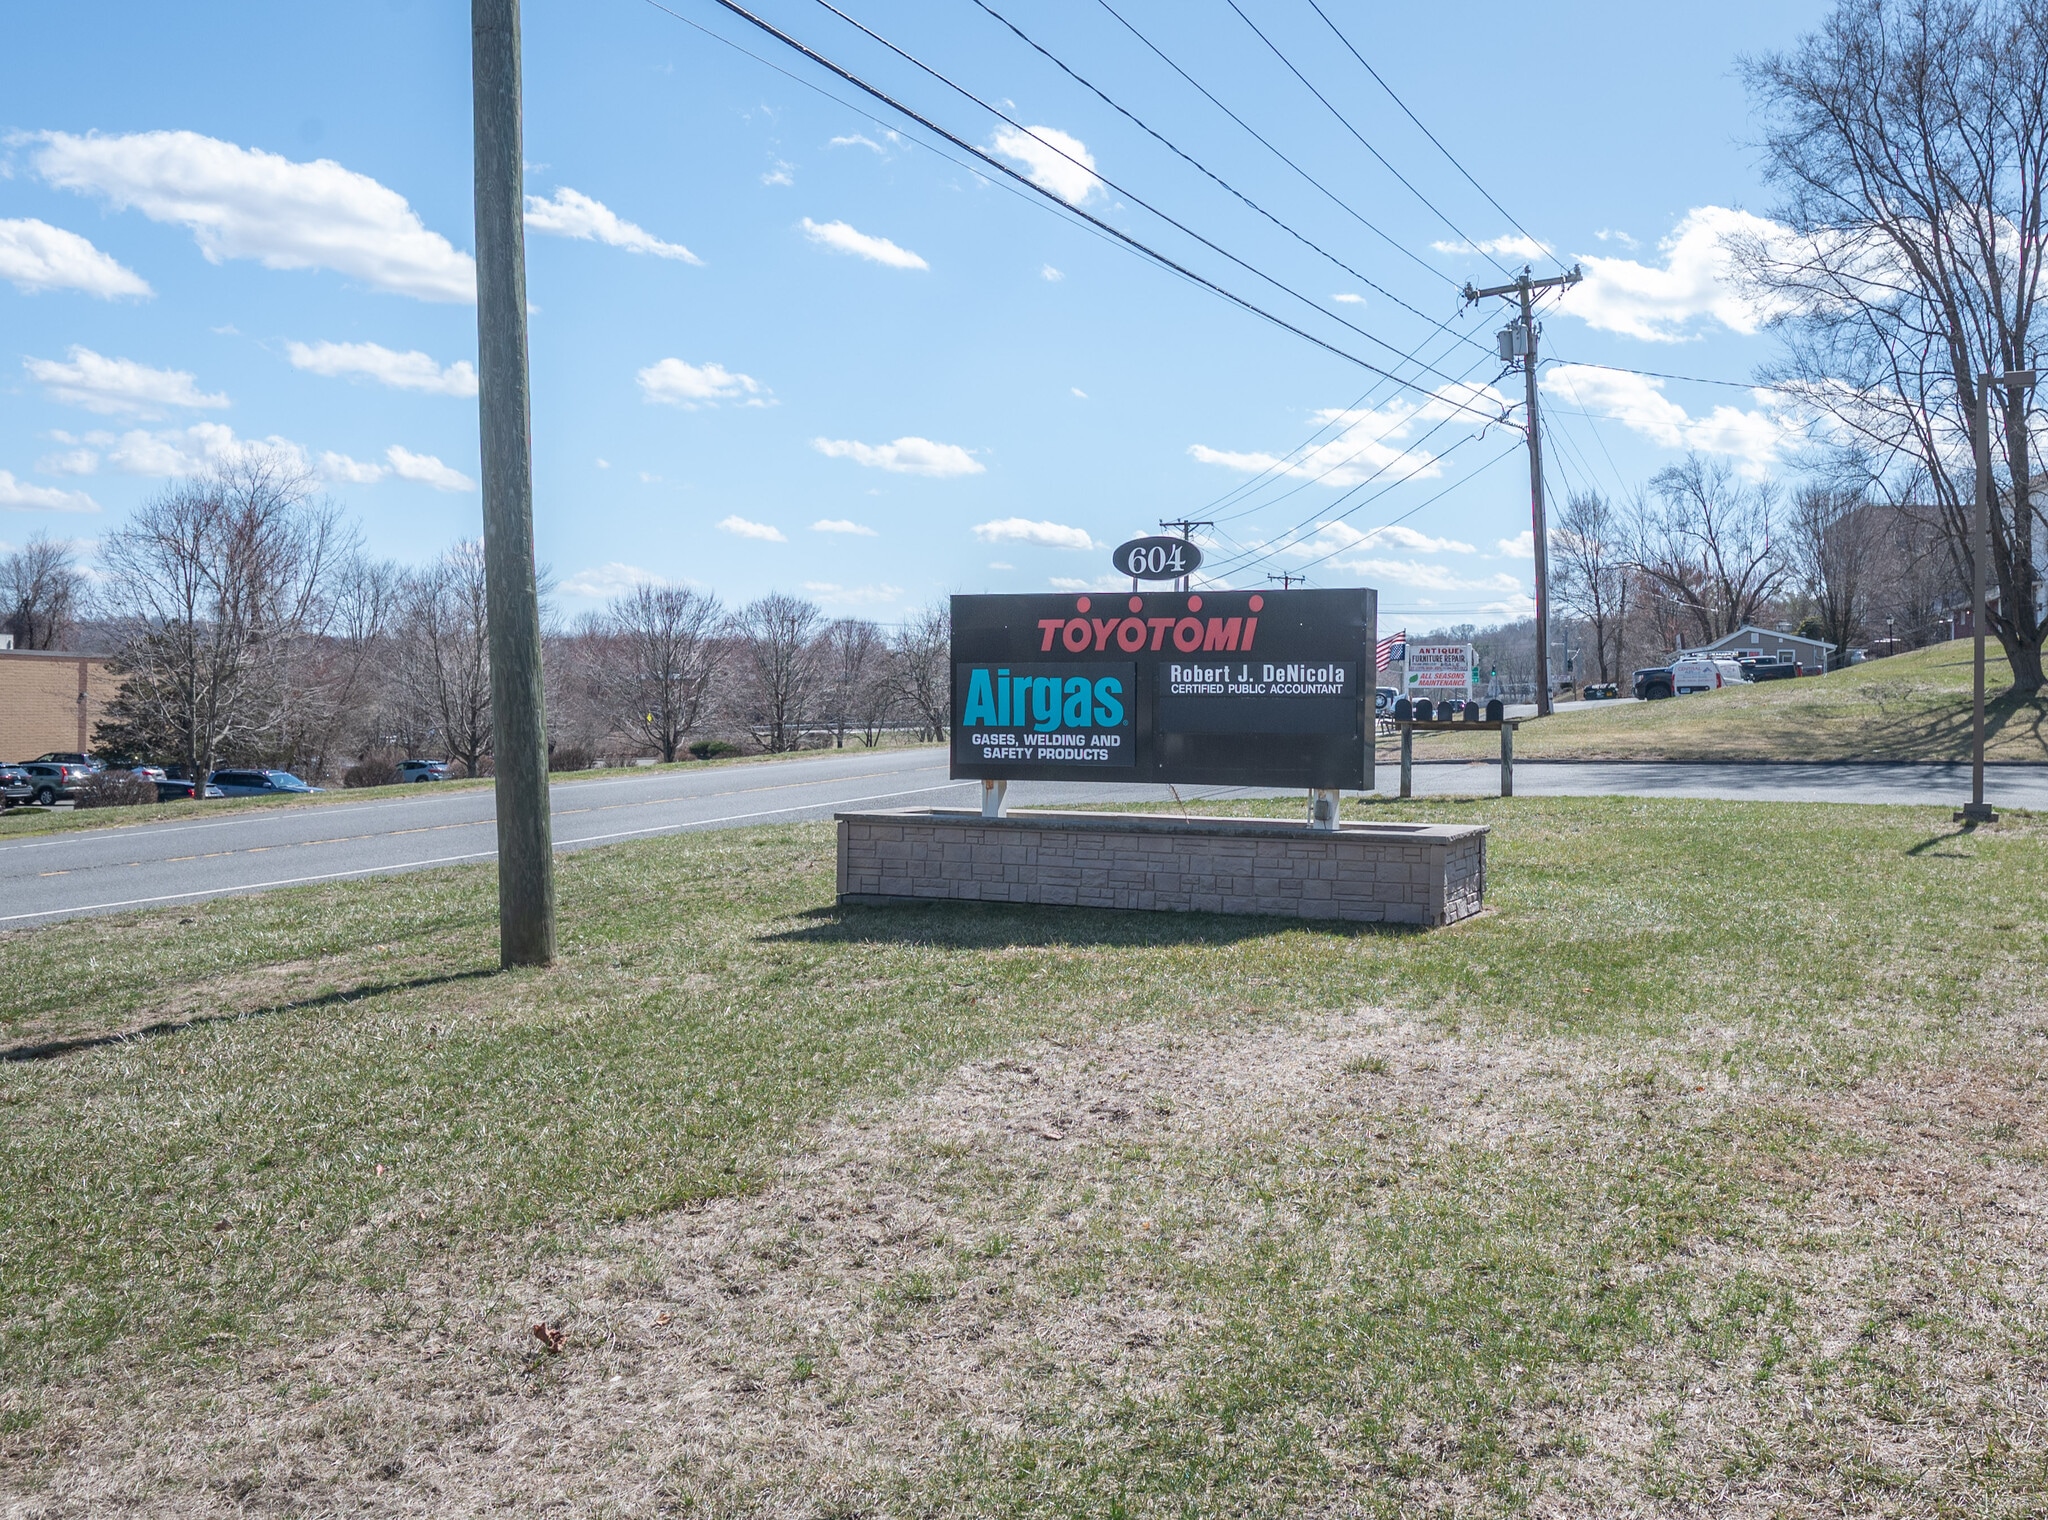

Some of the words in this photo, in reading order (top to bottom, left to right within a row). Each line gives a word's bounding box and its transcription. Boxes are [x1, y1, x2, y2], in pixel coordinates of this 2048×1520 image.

[1128, 544, 1186, 575] 604
[1412, 655, 1443, 663] FURNITURE
[1444, 655, 1465, 663] REPAIR
[1171, 664, 1230, 683] Robert
[1238, 664, 1254, 683] J.
[1263, 664, 1345, 683] DeNicola
[1171, 684, 1225, 695] CERTIFIED
[1228, 684, 1266, 695] PUBLIC
[1270, 684, 1344, 695] ACCOUNTANT
[963, 668, 1124, 732] Airgas
[972, 734, 1019, 748] GASES,
[1023, 734, 1086, 747] WELDING
[1091, 734, 1121, 747] AND
[983, 748, 1034, 761] SAFETY
[1038, 748, 1109, 761] PRODUCTS
